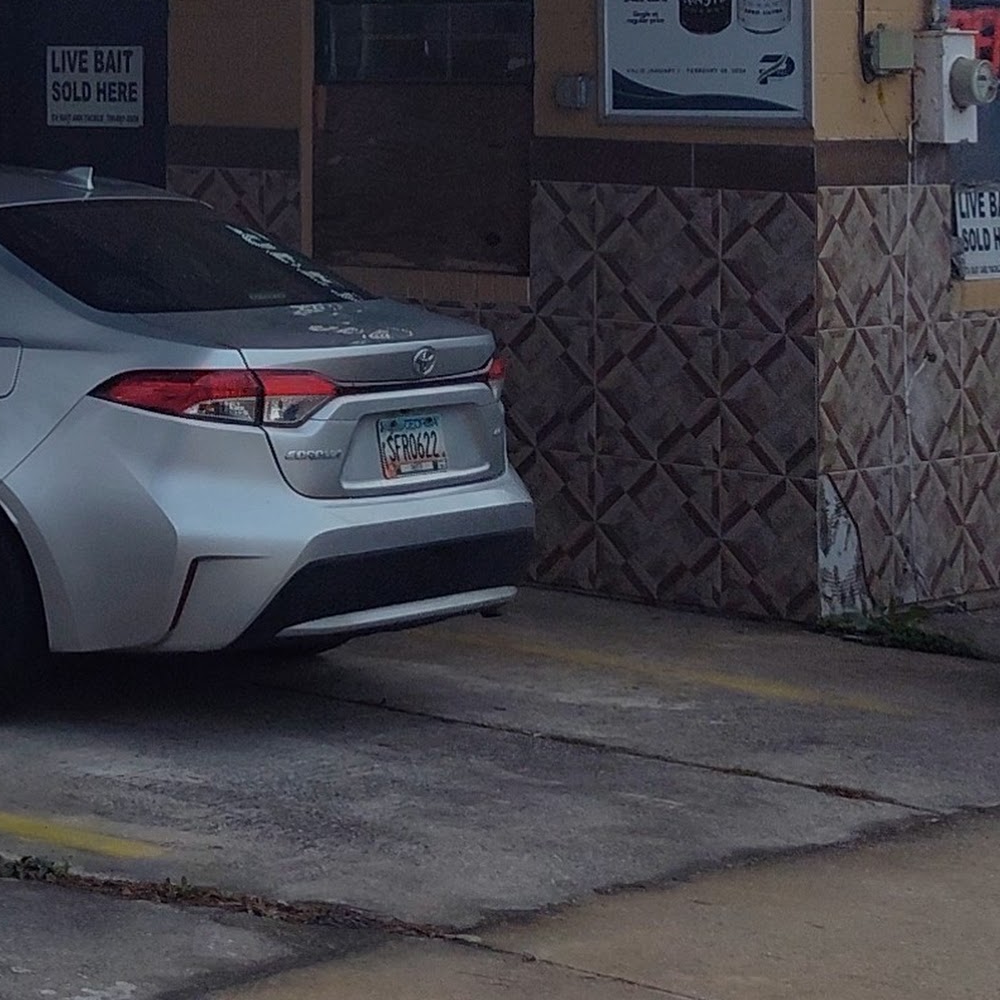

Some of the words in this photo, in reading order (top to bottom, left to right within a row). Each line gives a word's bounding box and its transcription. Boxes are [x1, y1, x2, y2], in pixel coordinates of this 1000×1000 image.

[51, 50, 88, 73] LIVE
[94, 50, 133, 73] BAIT
[51, 81, 91, 102] SOLD
[96, 82, 138, 102] HERE
[958, 192, 985, 218] LIVE
[962, 227, 991, 252] SOLD
